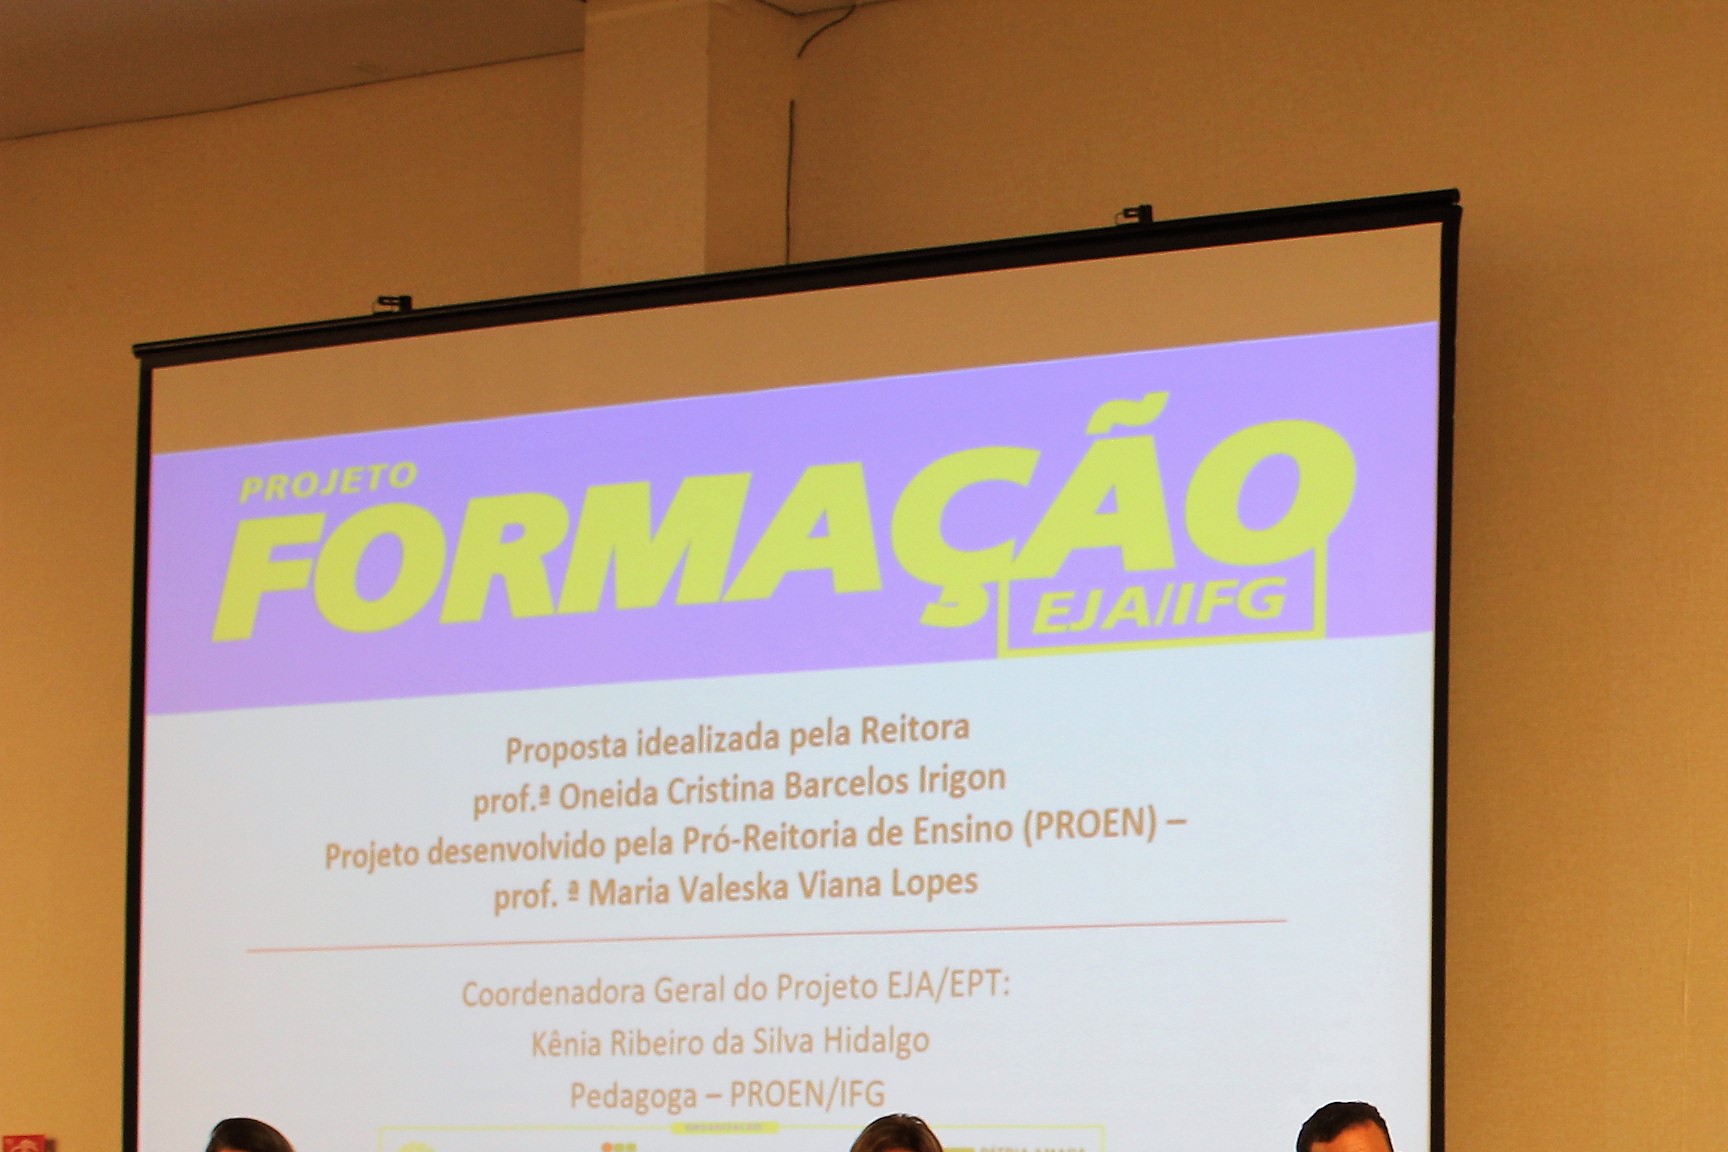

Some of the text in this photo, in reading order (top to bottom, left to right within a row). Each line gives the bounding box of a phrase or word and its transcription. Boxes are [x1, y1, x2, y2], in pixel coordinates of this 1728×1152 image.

[238, 460, 419, 504] PROJETO
[211, 390, 1358, 644] FORMAÇÃO
[1028, 572, 1292, 640] EJA/IFG
[506, 714, 970, 768] Proposta idealizada pela Reitora
[559, 777, 658, 810] Oneida
[667, 773, 775, 805] Cristina
[785, 765, 909, 799] Barcelos
[919, 763, 1006, 799] Irigon
[325, 841, 420, 875] Projeto
[427, 830, 606, 865] desenvolvido
[615, 827, 673, 864] pela
[683, 820, 857, 854] Pró-Reitoria
[867, 816, 903, 846] de
[914, 814, 1013, 845] Ensino
[1023, 805, 1157, 847] (PROEN)
[494, 879, 557, 917] prof.
[589, 876, 670, 906] Maria
[679, 871, 789, 903] Valeska
[798, 869, 881, 899] Viana
[892, 868, 978, 902] Lopes
[462, 967, 1009, 1008] Coordenadora Geral do Projeto EJA/EPT:
[532, 1025, 930, 1060] Kênia Ribeiro da Silva Hidalgo
[571, 1081, 698, 1116] Pedagoga
[731, 1077, 885, 1112] PROEN/IFG
